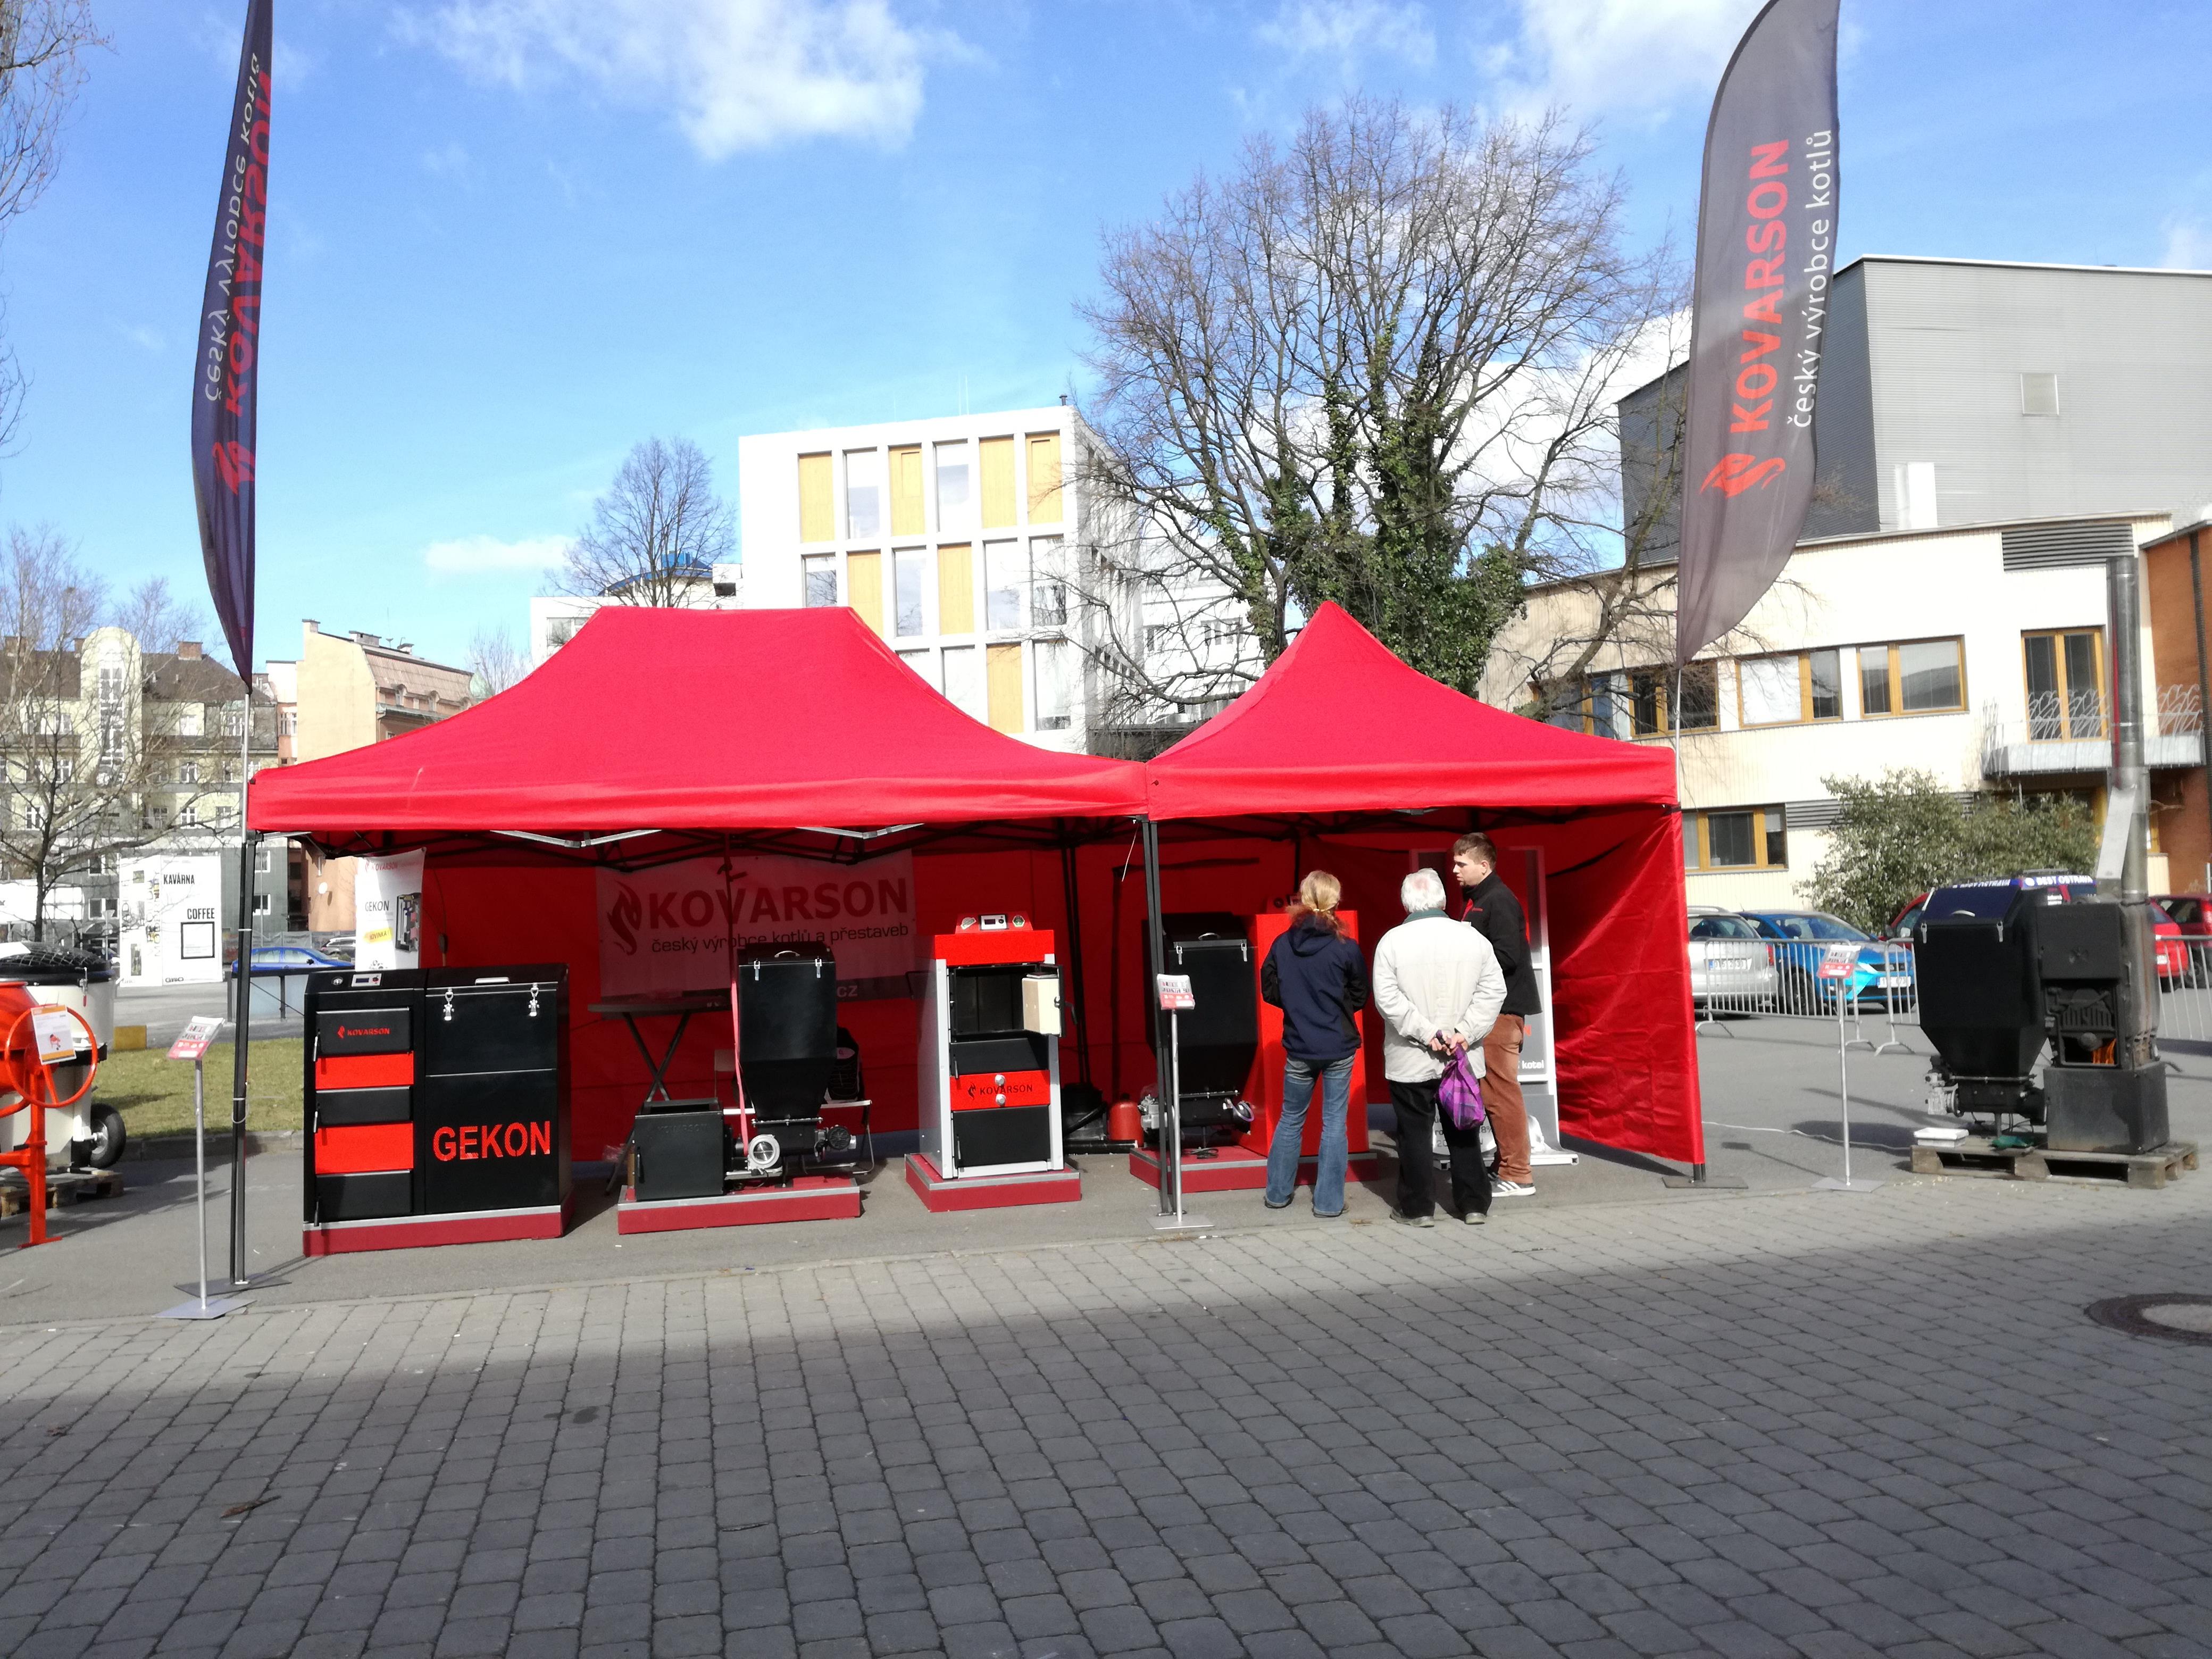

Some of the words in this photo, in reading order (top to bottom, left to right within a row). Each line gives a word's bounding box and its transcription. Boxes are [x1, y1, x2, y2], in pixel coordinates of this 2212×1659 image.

[1806, 129, 1832, 210] kotlů
[1731, 139, 1790, 433] KOVARSON
[1796, 218, 1830, 339] výrobce
[1787, 349, 1821, 429] český
[163, 873, 195, 885] KAVÁRNA
[2036, 877, 2057, 885] BEST
[2058, 876, 2093, 885] OSTRAVA
[187, 908, 215, 920] COFFEE
[365, 901, 390, 912] GEKON
[649, 878, 908, 929] KOVARSON
[652, 937, 700, 954] český
[703, 932, 767, 952] výrobce
[772, 929, 811, 945] kotlů
[816, 931, 825, 941] a
[830, 923, 908, 945] přestaveb
[347, 1028, 390, 1036] KOVARSON
[1522, 1060, 1545, 1069] kotel
[980, 1084, 1033, 1096] KOVARSON
[433, 1121, 550, 1162] GEKON
